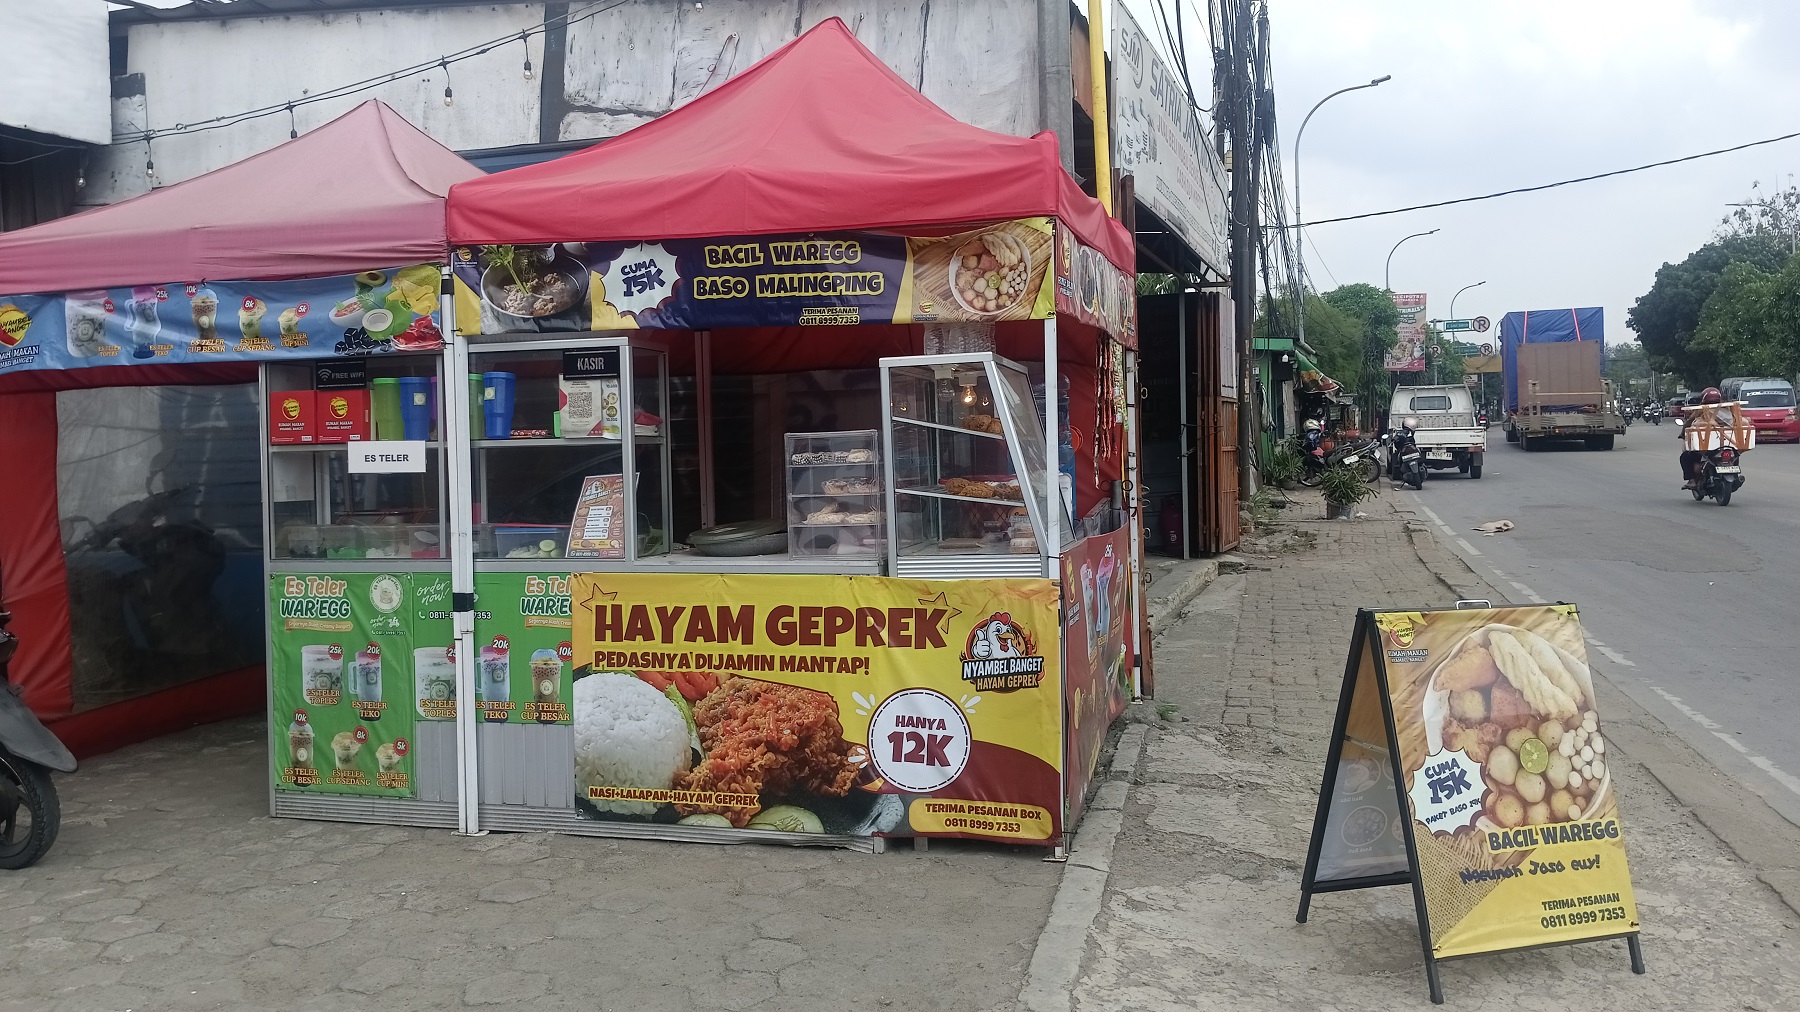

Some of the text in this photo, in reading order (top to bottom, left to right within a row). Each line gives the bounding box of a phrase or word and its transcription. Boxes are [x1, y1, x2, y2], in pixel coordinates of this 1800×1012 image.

[1121, 28, 1140, 68] SJM
[1150, 58, 1181, 132] SATRIA
[707, 243, 859, 265] BACIL WAREGG
[620, 259, 658, 275] CUMA
[622, 268, 666, 297] 15K
[696, 275, 883, 297] BASO MALINGPING
[800, 317, 817, 325] 0811
[839, 316, 859, 324] 7353
[199, 338, 225, 346] TELER
[577, 357, 605, 371] KASIR
[364, 454, 409, 463] ES TELER
[285, 576, 346, 595] Es Teler
[416, 578, 450, 596] order
[526, 576, 572, 594] Es Tel
[421, 588, 450, 605] now!
[281, 599, 350, 617] WAR'EGG
[595, 604, 948, 649] HAYAM GEPREK
[329, 646, 342, 654] 25k
[367, 646, 380, 654] 20k
[492, 640, 508, 649] 20k
[559, 647, 572, 656] 10k
[594, 651, 870, 675] PEDASNYA DIJAMIN MANTAP!
[963, 658, 1043, 679] NYAMBEL BANGET
[977, 674, 1038, 690] HAYAM GEPREK
[317, 689, 341, 697] TELER
[309, 697, 338, 705] TOPLES
[364, 701, 387, 709] TELER
[420, 700, 431, 708] ES
[488, 701, 516, 710] TELER
[538, 703, 566, 711] TELER
[295, 713, 307, 721] 10k
[360, 710, 380, 718] TEKO
[424, 709, 456, 718] TOPLES
[484, 711, 508, 719] TEKO
[521, 712, 570, 721] CUP BESAR
[895, 715, 947, 731] HANYA
[356, 731, 366, 739] 8k
[396, 741, 406, 750] 5k
[887, 731, 954, 767] 12K
[294, 768, 318, 776] TELER
[1424, 758, 1460, 779] CUMA
[297, 776, 322, 784] BESAR
[341, 777, 371, 786] SEDANG
[1427, 768, 1472, 804] 15K
[715, 794, 758, 807] GEPREK
[925, 803, 1042, 820] TERIMA PESANAN BOX
[1425, 810, 1447, 825] PAKET
[1449, 803, 1467, 816] BASO
[944, 818, 1021, 833] 0811 8999 7353
[1488, 820, 1619, 851] BACIL WAREGG
[1571, 854, 1600, 871] euy!
[1541, 892, 1620, 911] TERIMA PESANAN
[1540, 907, 1626, 929] 0811 8999 7353
